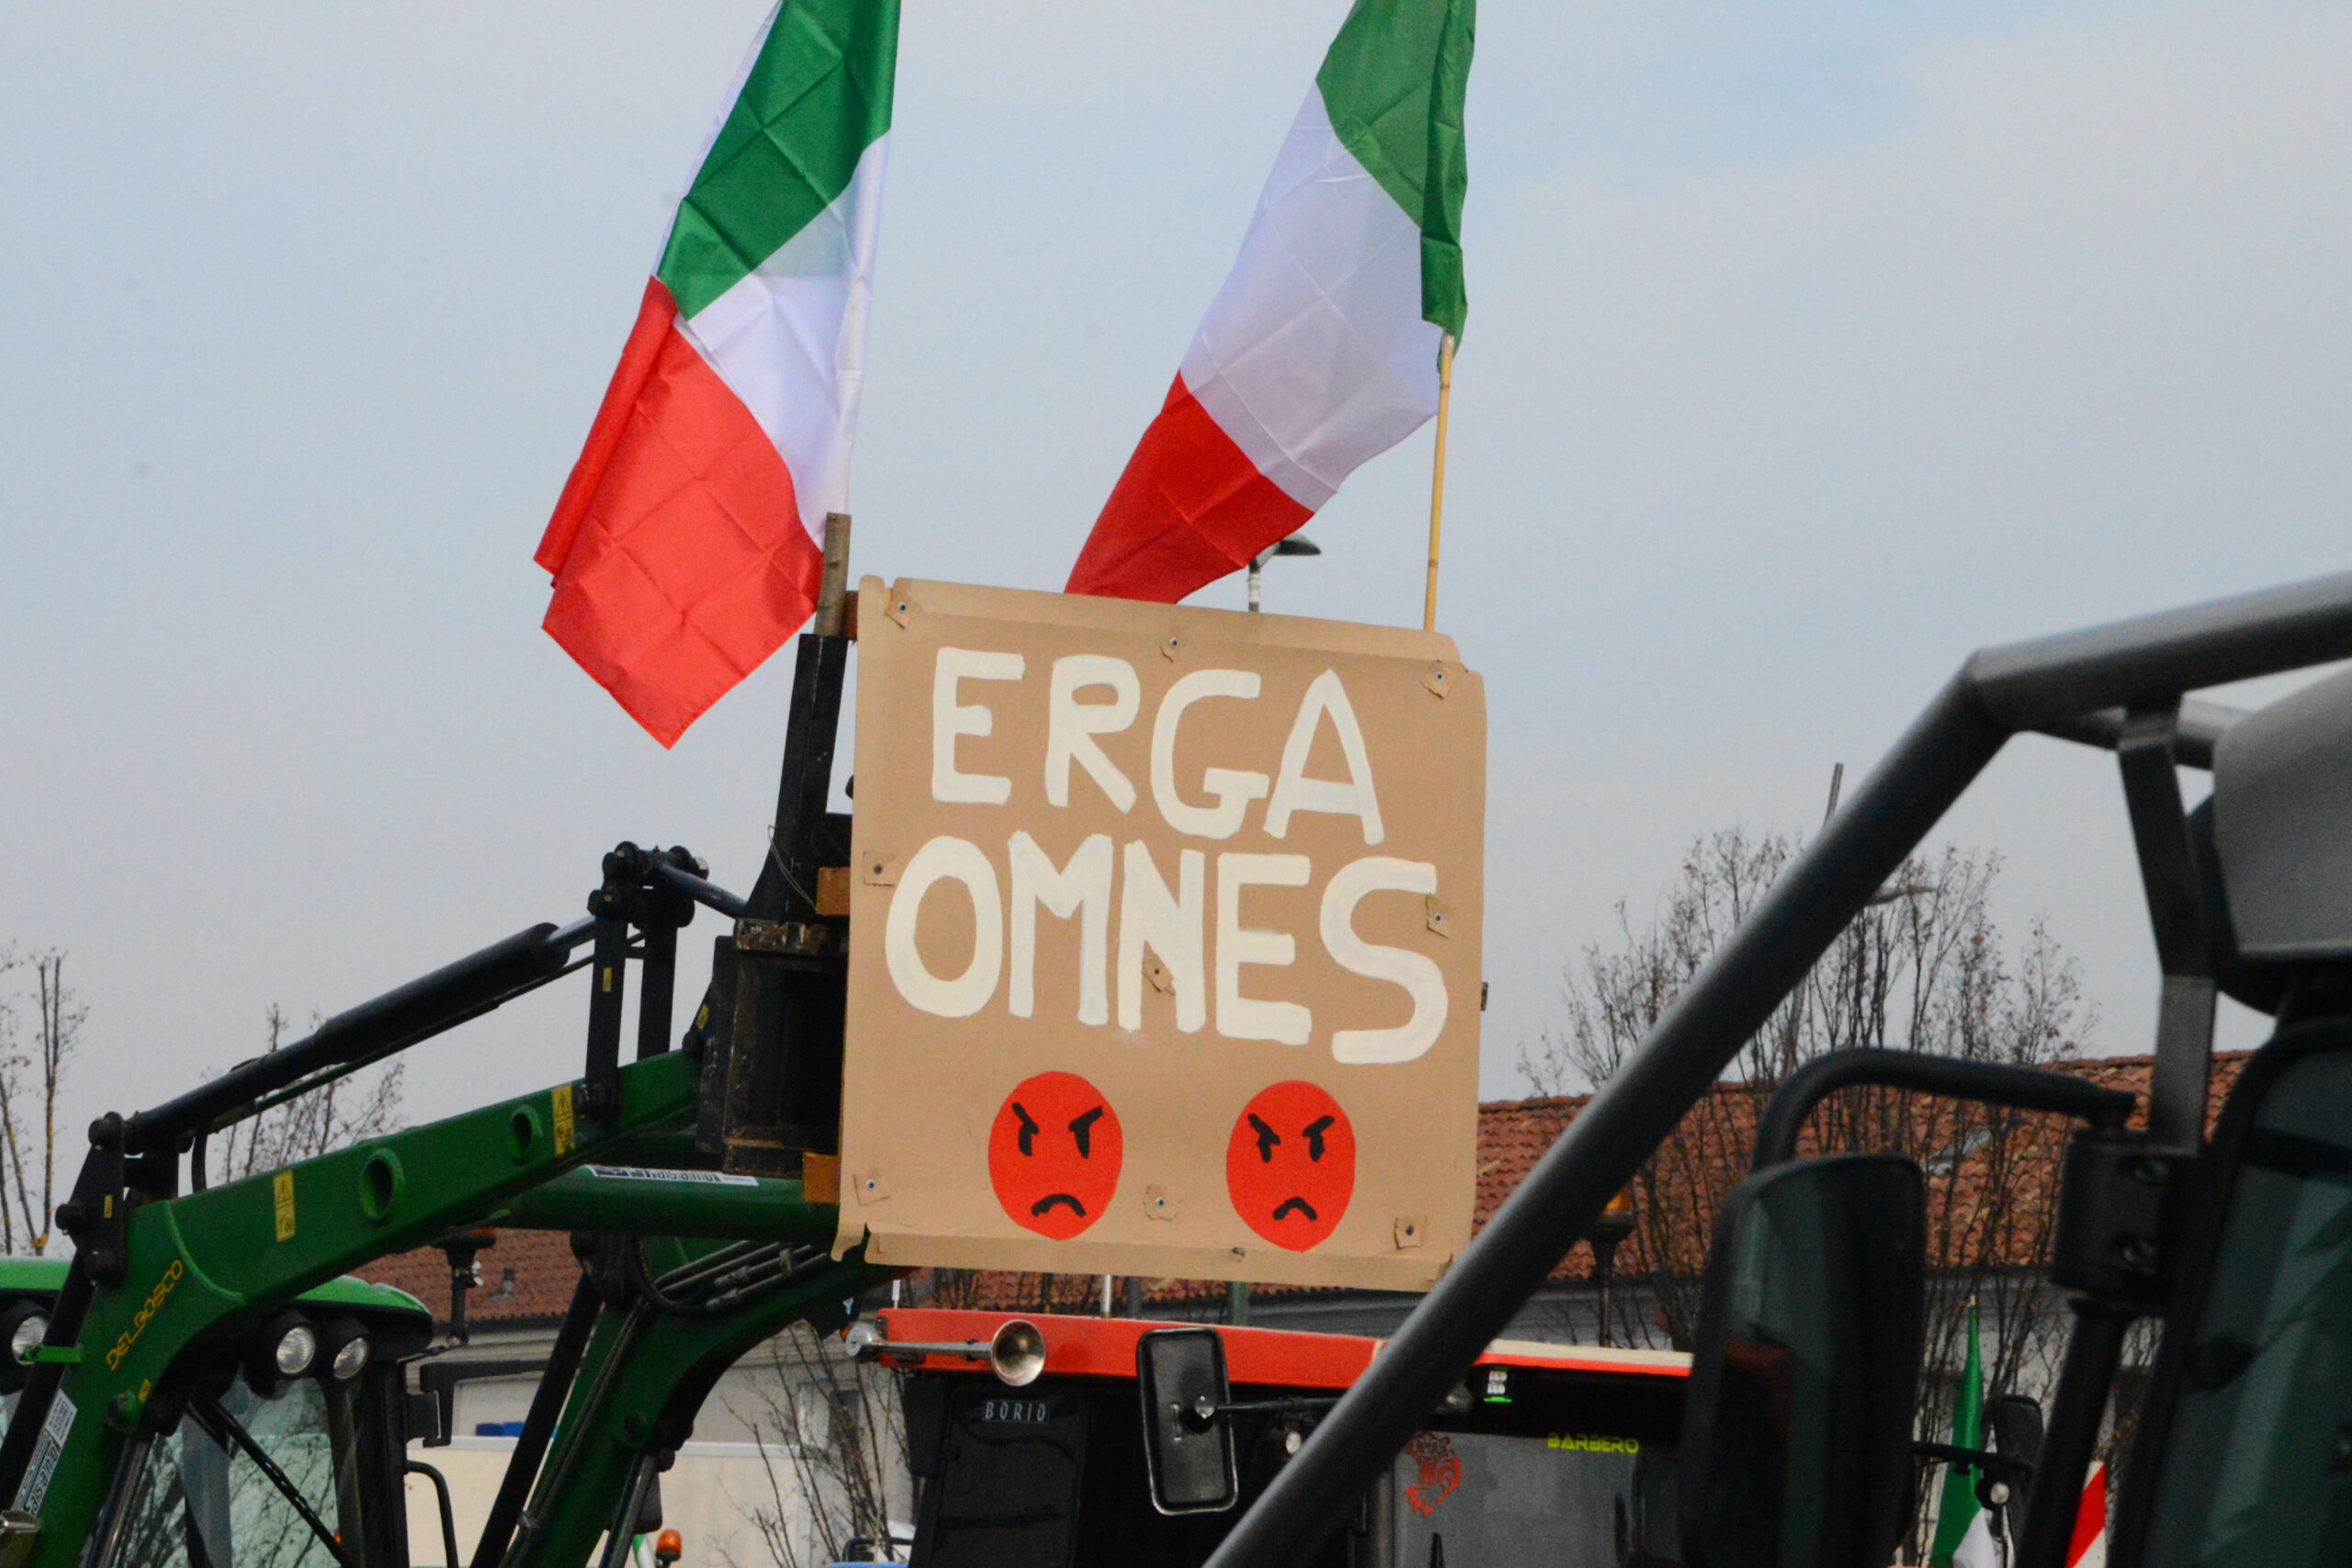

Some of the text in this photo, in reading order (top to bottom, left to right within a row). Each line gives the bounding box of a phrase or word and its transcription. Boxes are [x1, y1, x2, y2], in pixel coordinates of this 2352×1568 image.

[932, 647, 1385, 845] ERGA
[885, 829, 1448, 1065] OMNES
[106, 1259, 183, 1371] DELBOSCO
[985, 1402, 1046, 1421] BORIO
[1547, 1432, 1639, 1454] BARBERO
